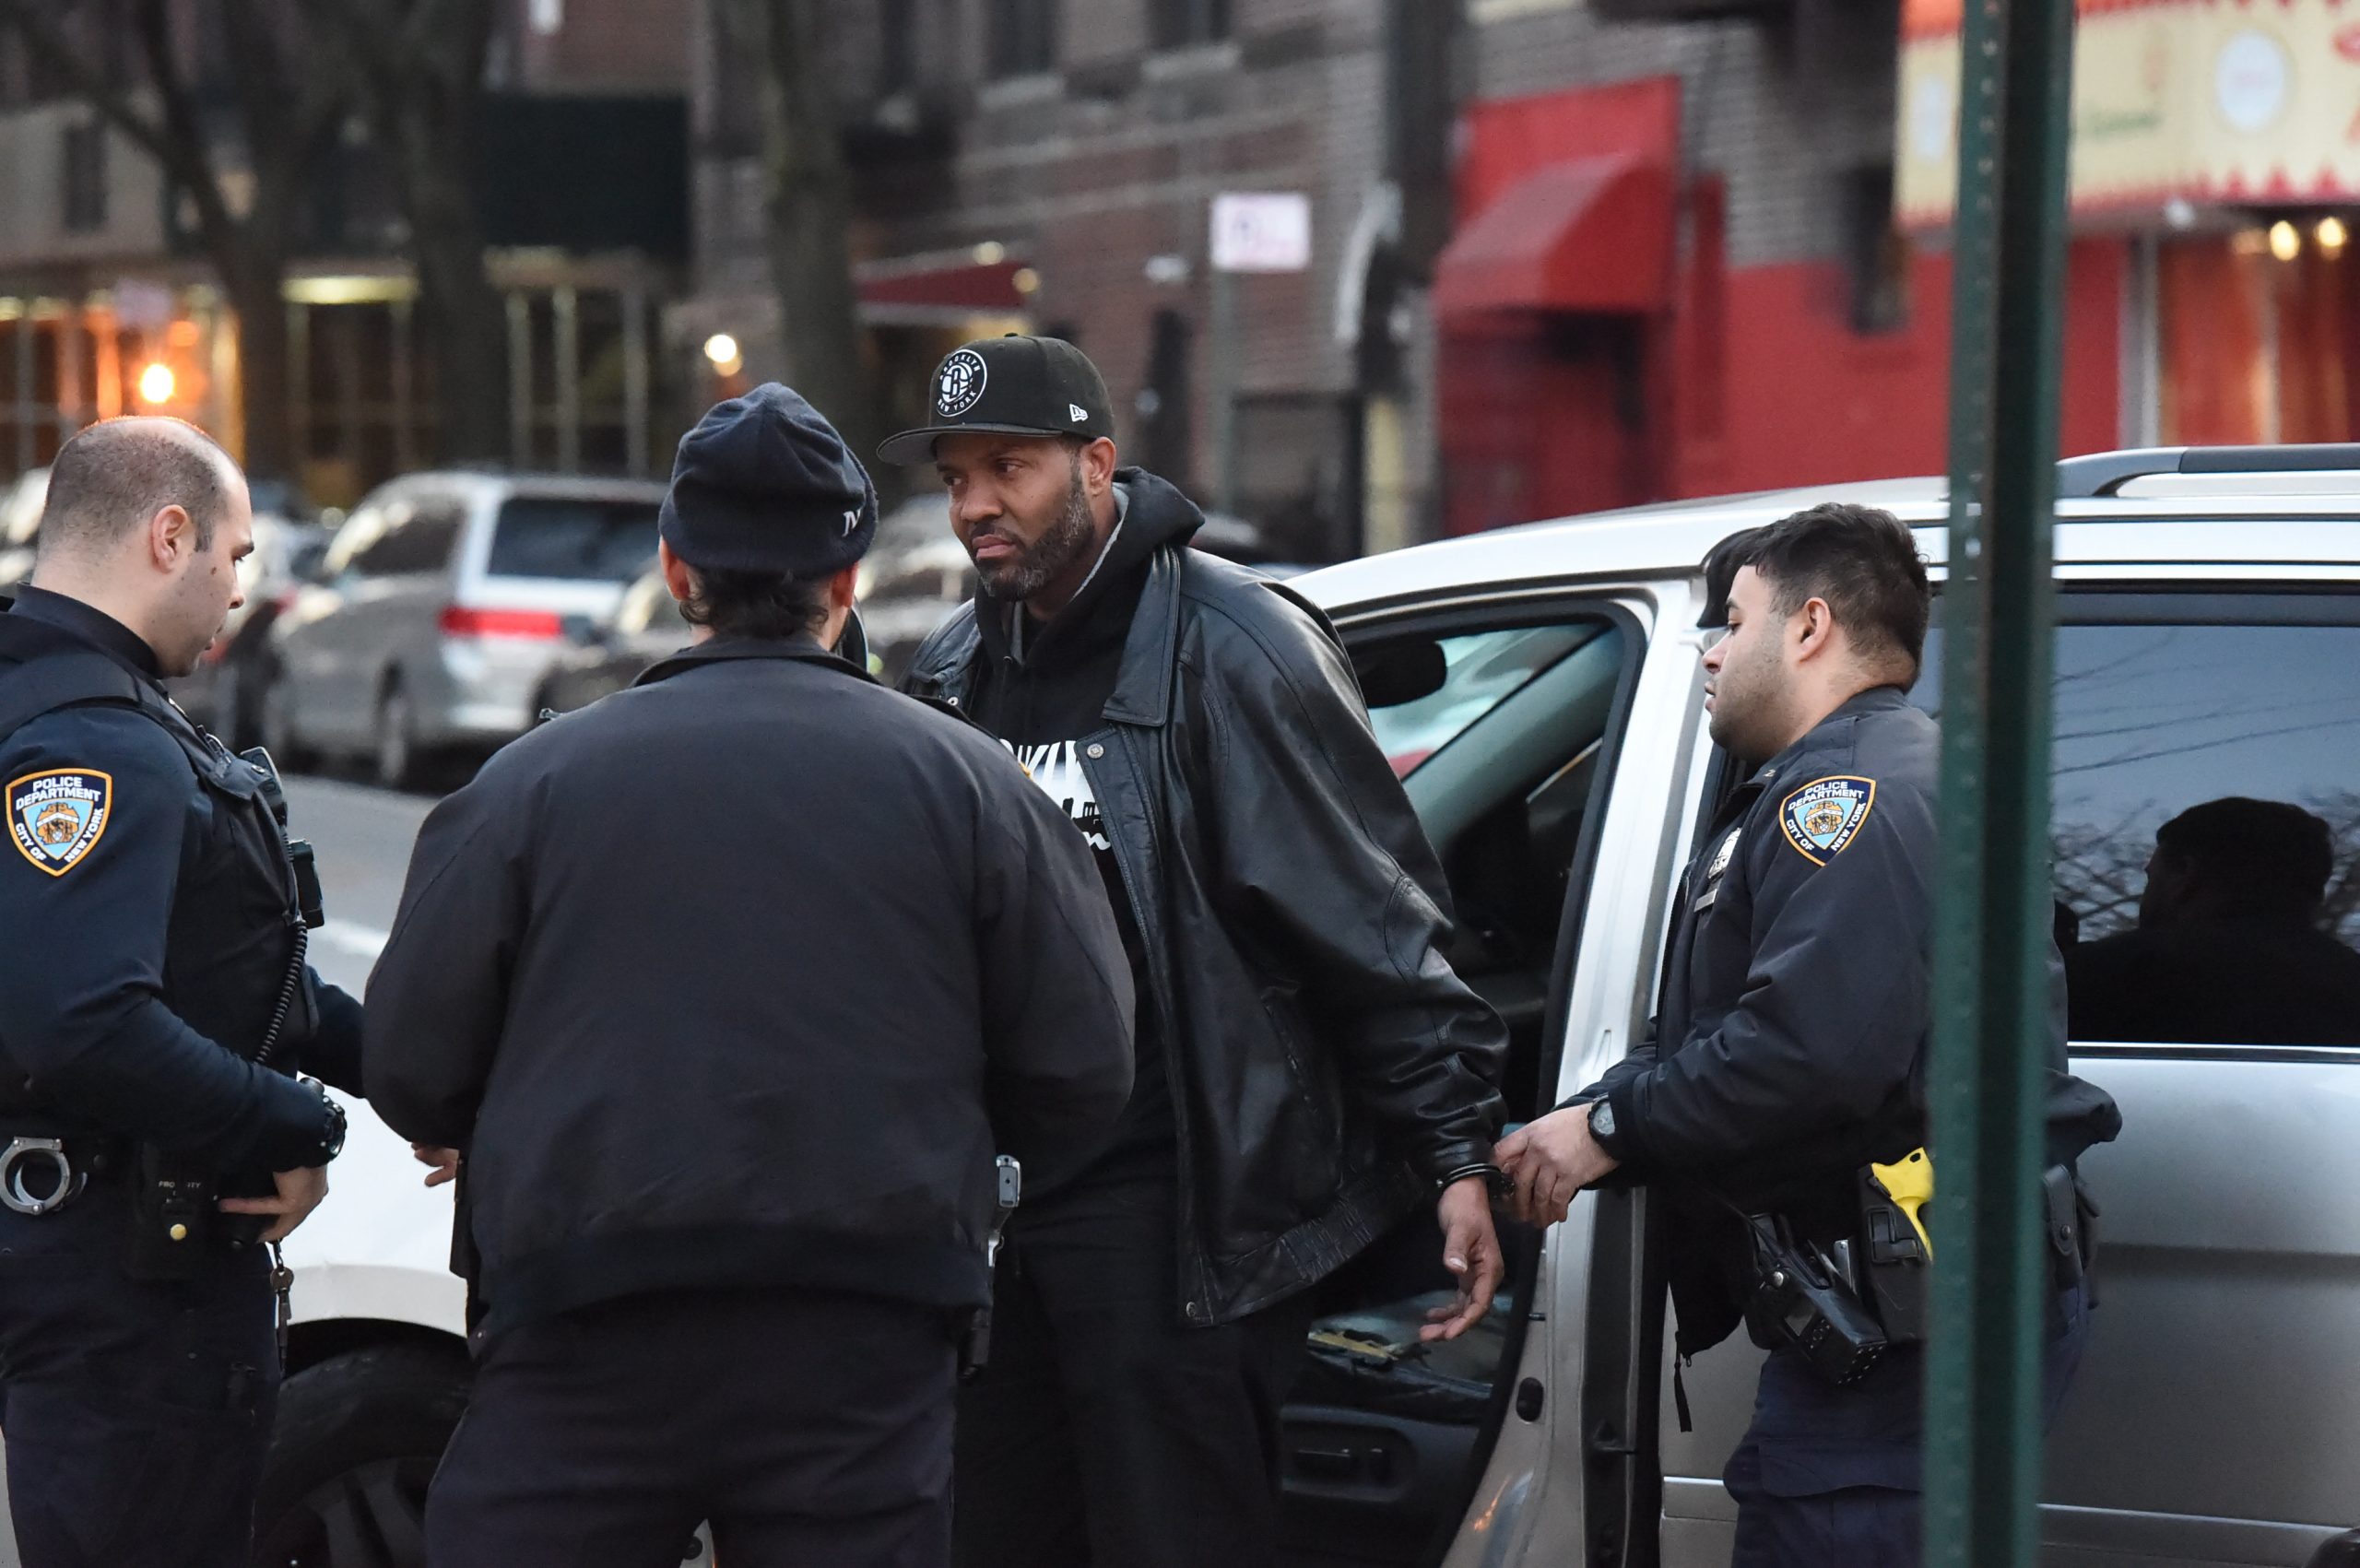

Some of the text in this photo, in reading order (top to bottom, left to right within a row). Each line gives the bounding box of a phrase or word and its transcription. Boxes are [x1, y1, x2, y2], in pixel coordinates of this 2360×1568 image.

[939, 354, 981, 381] BROOKLYN
[938, 390, 977, 412] NEW YORK
[32, 776, 83, 792] POLICE
[1804, 781, 1848, 796] POLICE
[16, 787, 101, 811] DEPARTMENT
[1788, 789, 1865, 811] DEPARTMENT
[64, 808, 104, 864] NEW YORK
[1786, 819, 1815, 852] CITY OF
[1830, 802, 1867, 852] NEW YORK
[16, 822, 48, 862] CITY OF
